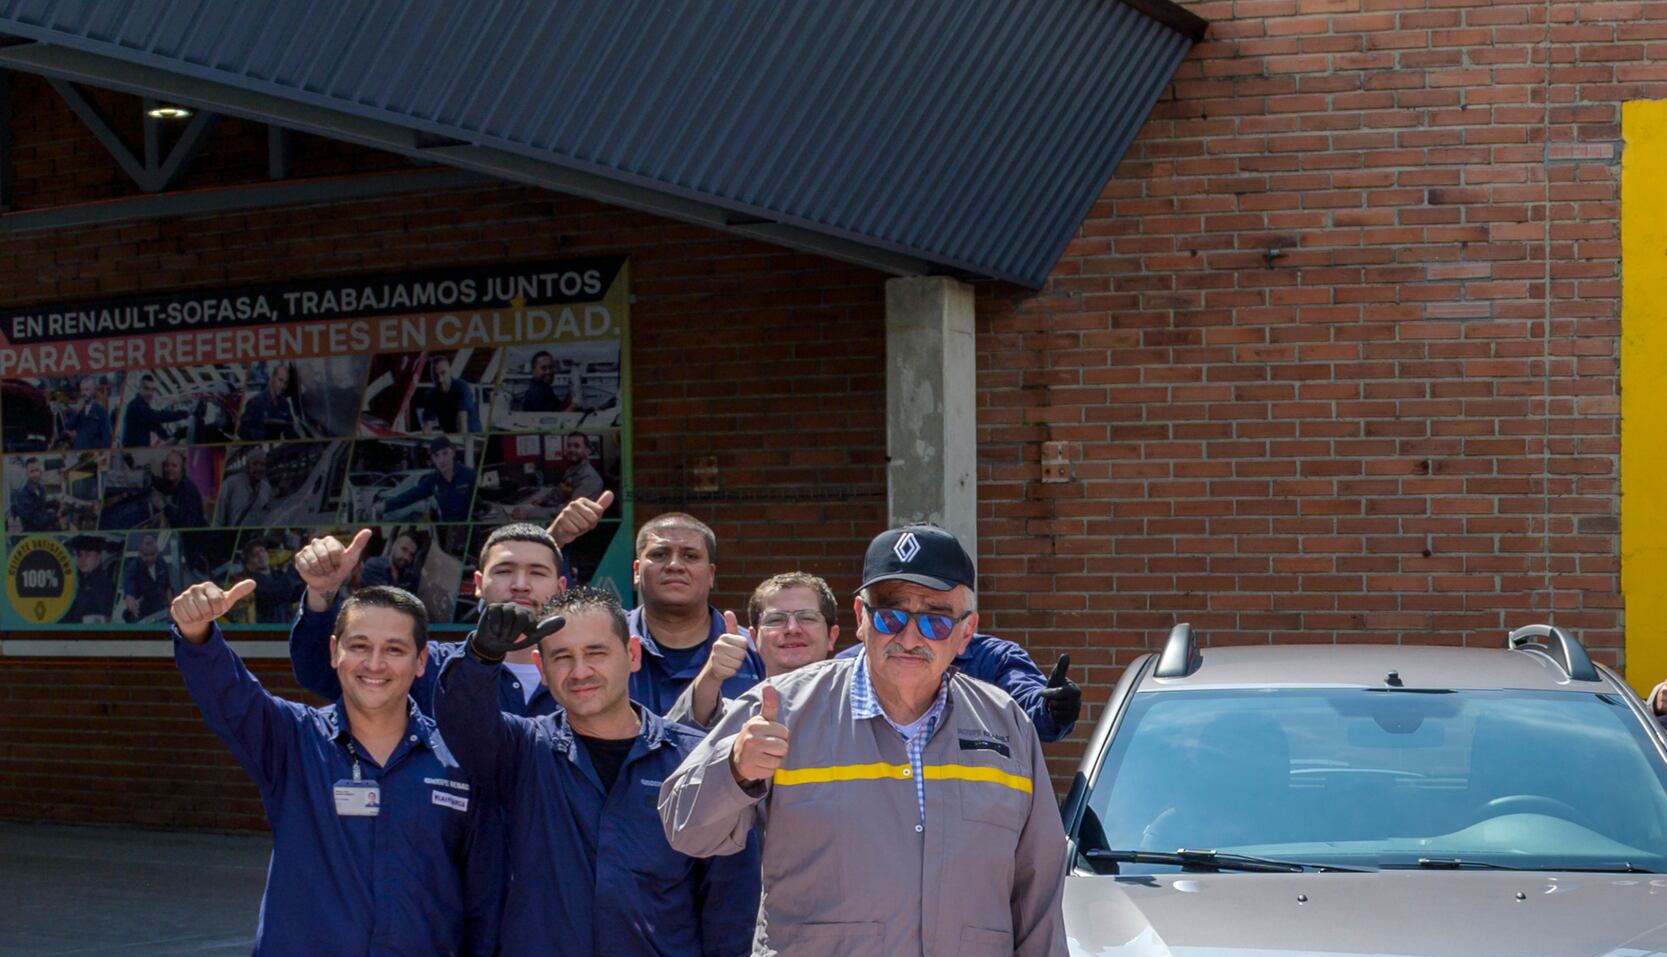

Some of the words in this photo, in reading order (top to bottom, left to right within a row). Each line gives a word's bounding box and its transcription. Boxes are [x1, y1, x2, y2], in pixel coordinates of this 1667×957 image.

[12, 315, 44, 340] EN
[48, 294, 279, 338] RENAULT-SOFASA,
[283, 278, 477, 316] TRABAJAMOS
[483, 269, 602, 302] JUNTOS
[0, 345, 82, 376] PARA
[87, 340, 146, 370] SER
[154, 320, 371, 366] REFERENTES
[379, 317, 426, 349] EN
[434, 305, 622, 346] CALIDAD.
[22, 568, 59, 590] 100%
